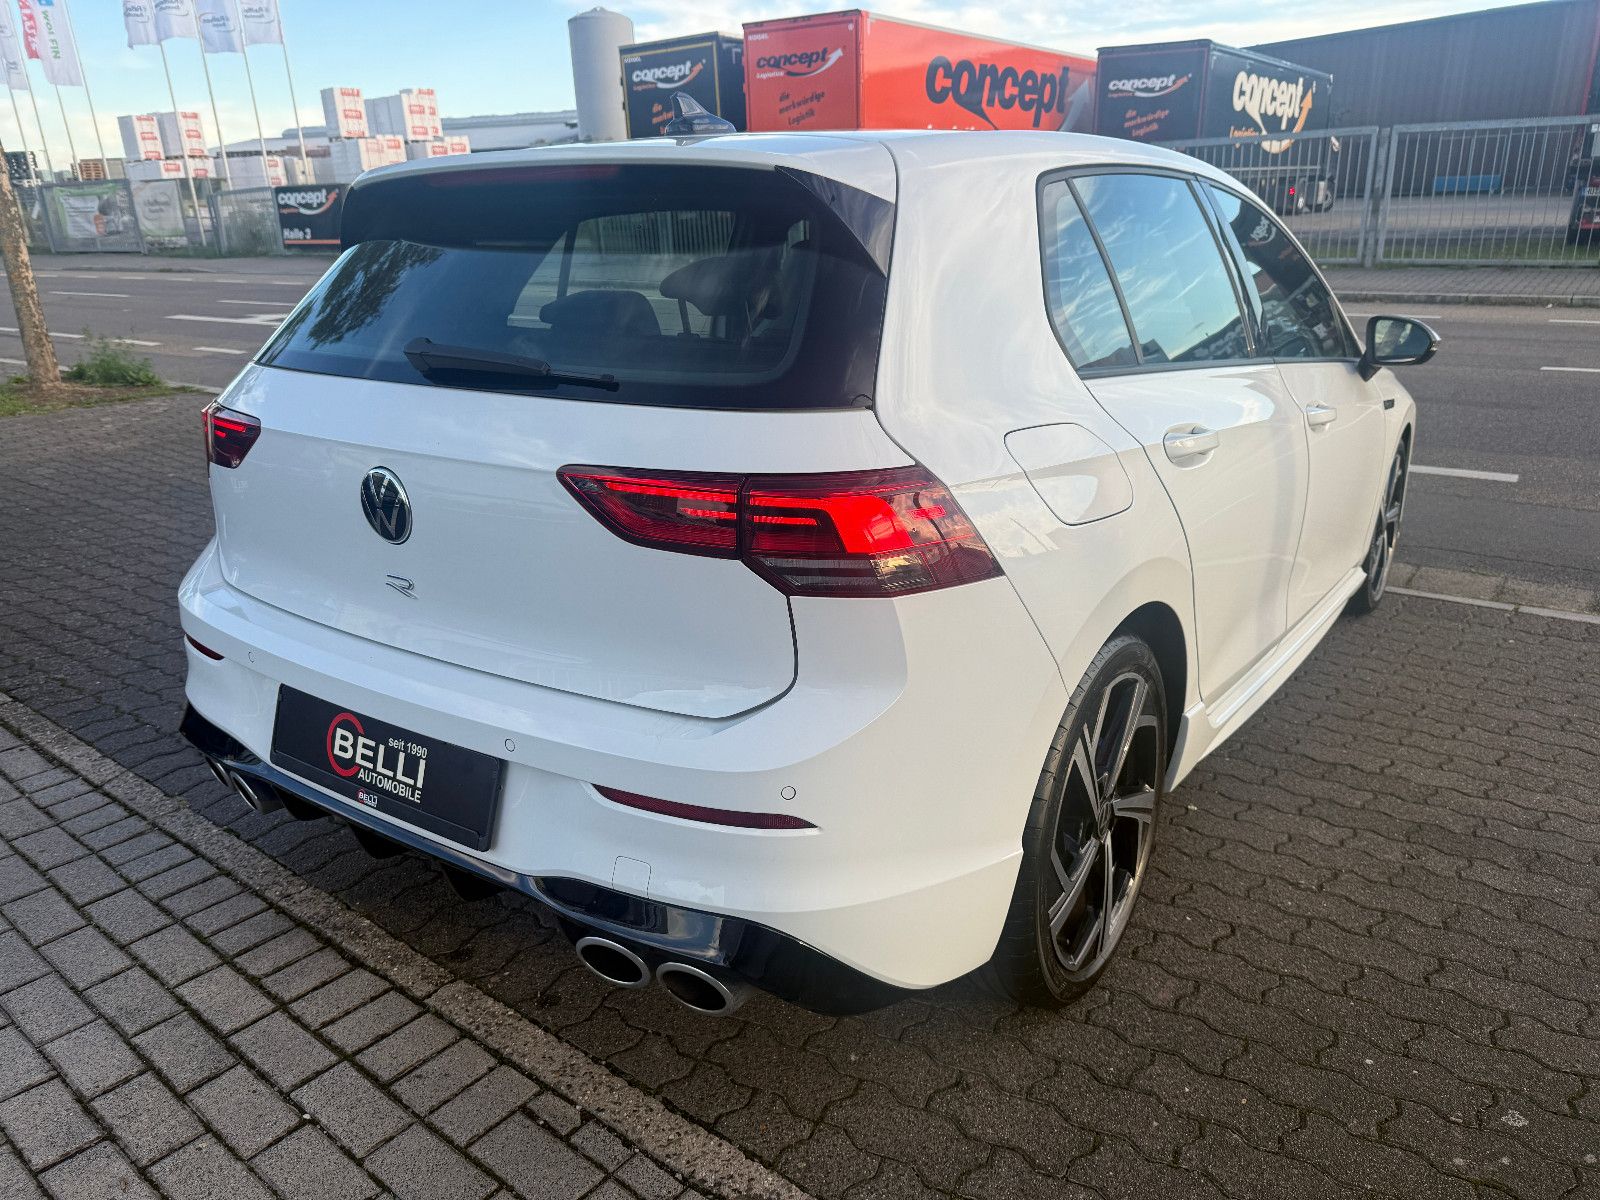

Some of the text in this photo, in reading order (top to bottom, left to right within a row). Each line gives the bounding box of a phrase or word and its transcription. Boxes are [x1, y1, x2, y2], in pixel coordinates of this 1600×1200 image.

[756, 47, 828, 69] concept
[632, 60, 692, 82] concept
[925, 55, 1070, 129] concept
[1108, 74, 1176, 91] concept
[1232, 71, 1304, 132] concept
[277, 188, 327, 208] concept
[333, 727, 427, 789] BELLI
[388, 737, 428, 759] seit 1990
[357, 768, 422, 804] AUTOMOBILE
